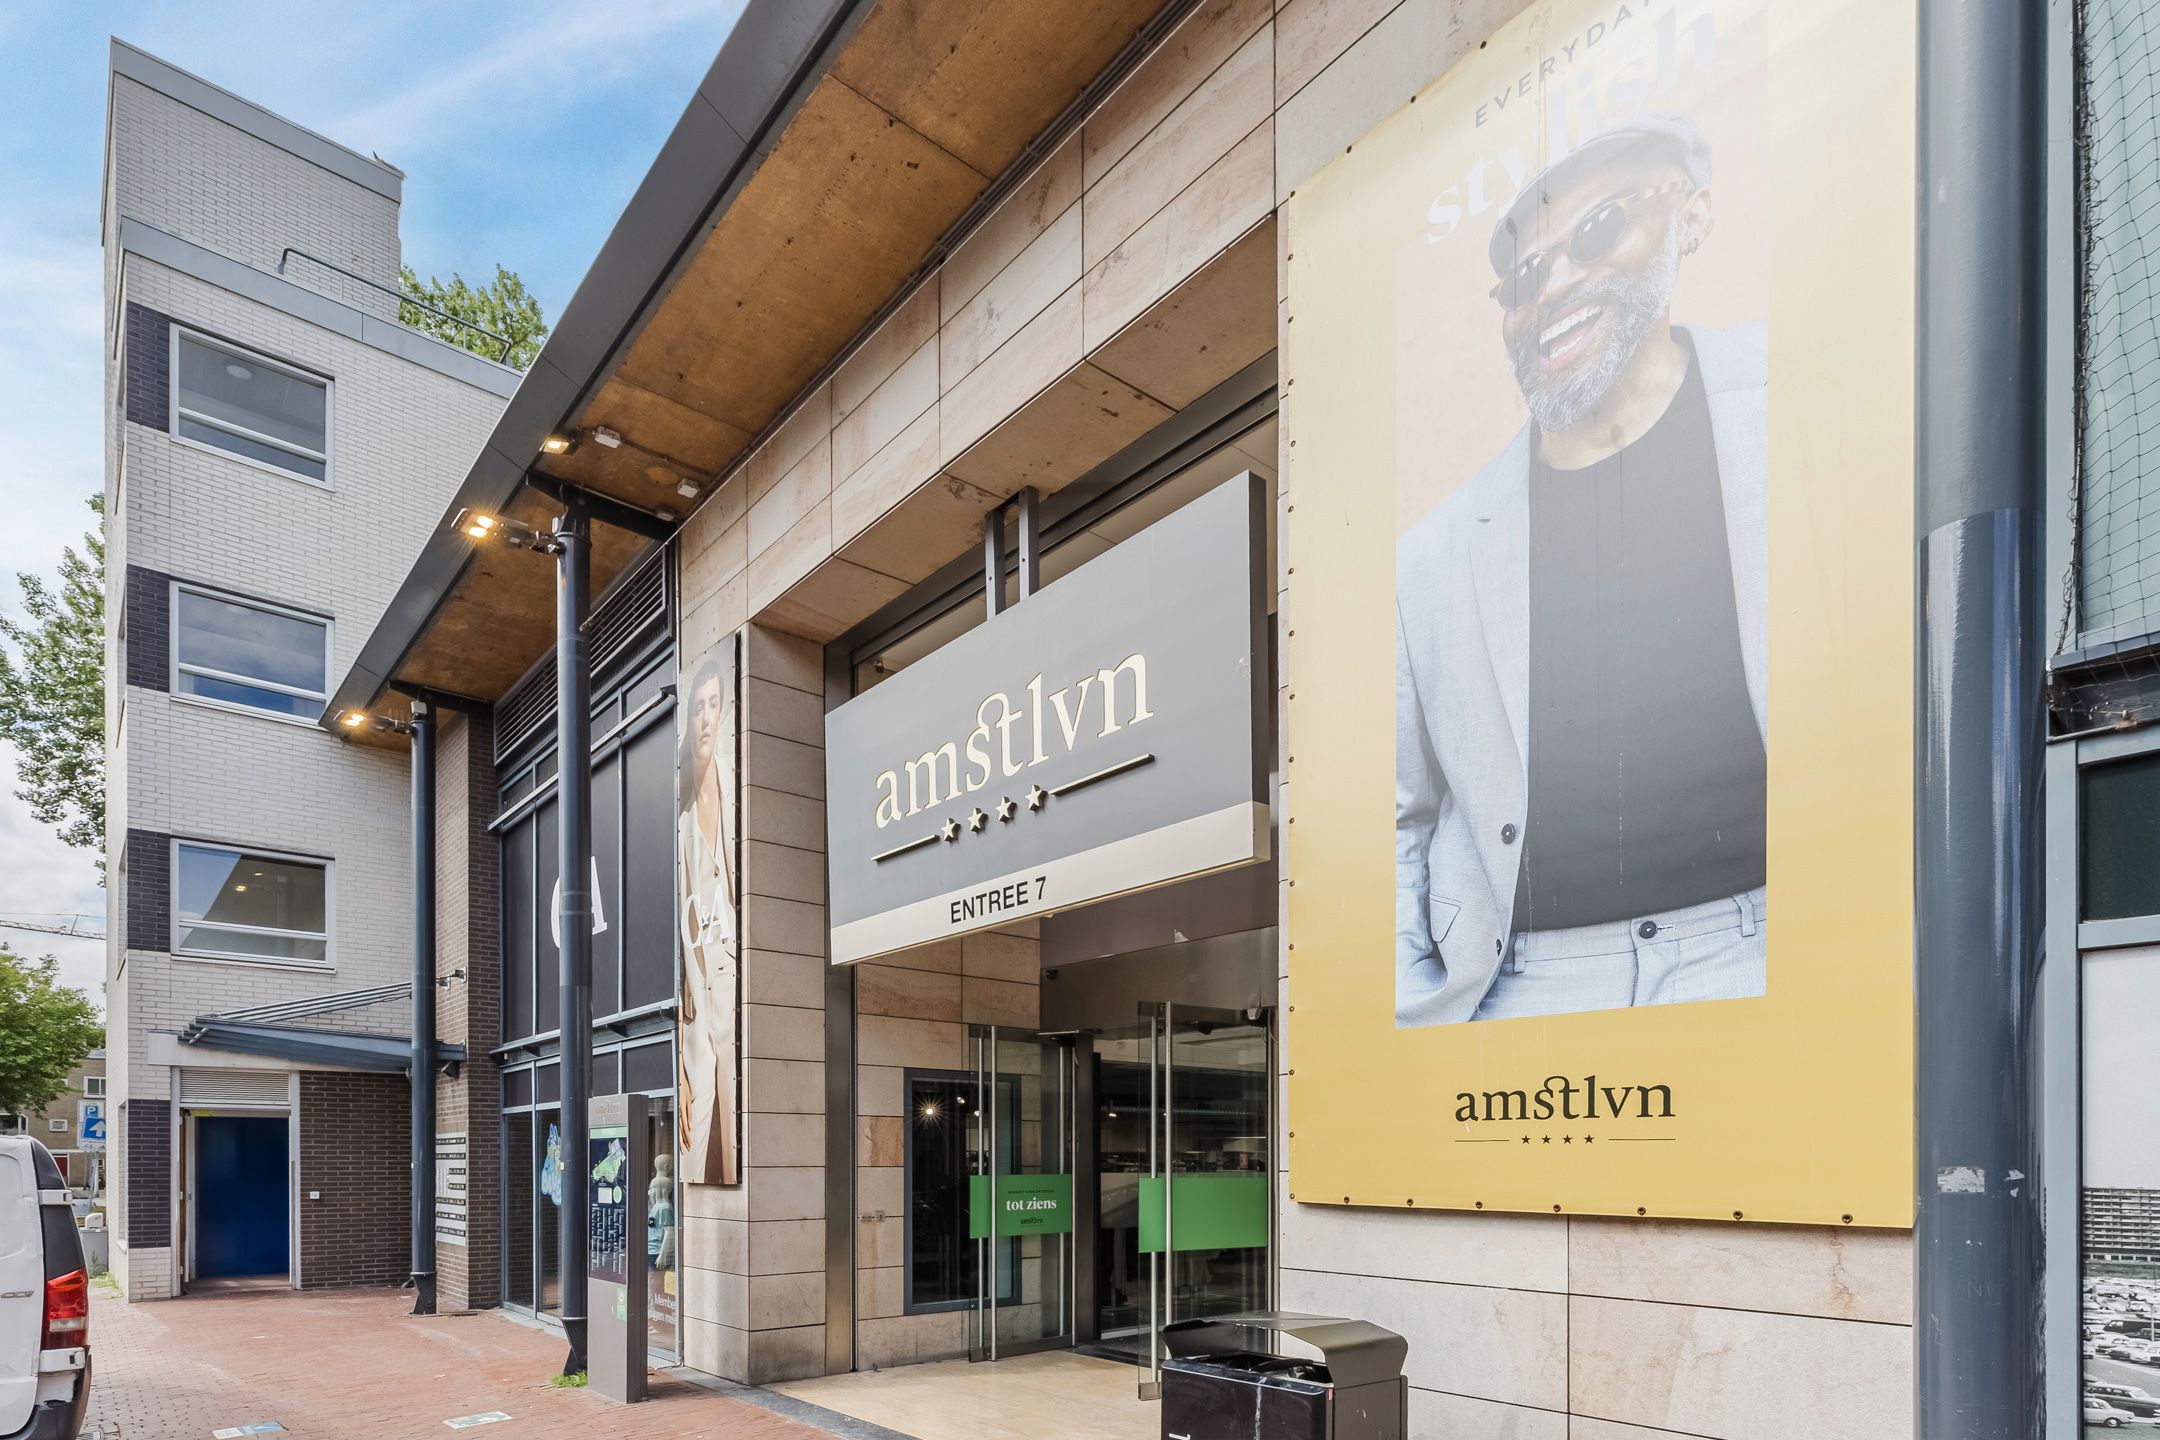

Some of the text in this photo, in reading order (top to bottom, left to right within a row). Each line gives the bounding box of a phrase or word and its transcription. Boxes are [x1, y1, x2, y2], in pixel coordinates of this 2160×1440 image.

[1475, 0, 1650, 128] EVERYDA
[875, 653, 1154, 829] amstlvn
[681, 883, 732, 949] C&A
[950, 876, 1047, 924] ENTREE 7
[87, 1106, 96, 1115] P
[1455, 1075, 1676, 1122] amstlvn
[1006, 1197, 1057, 1211] tot ziens
